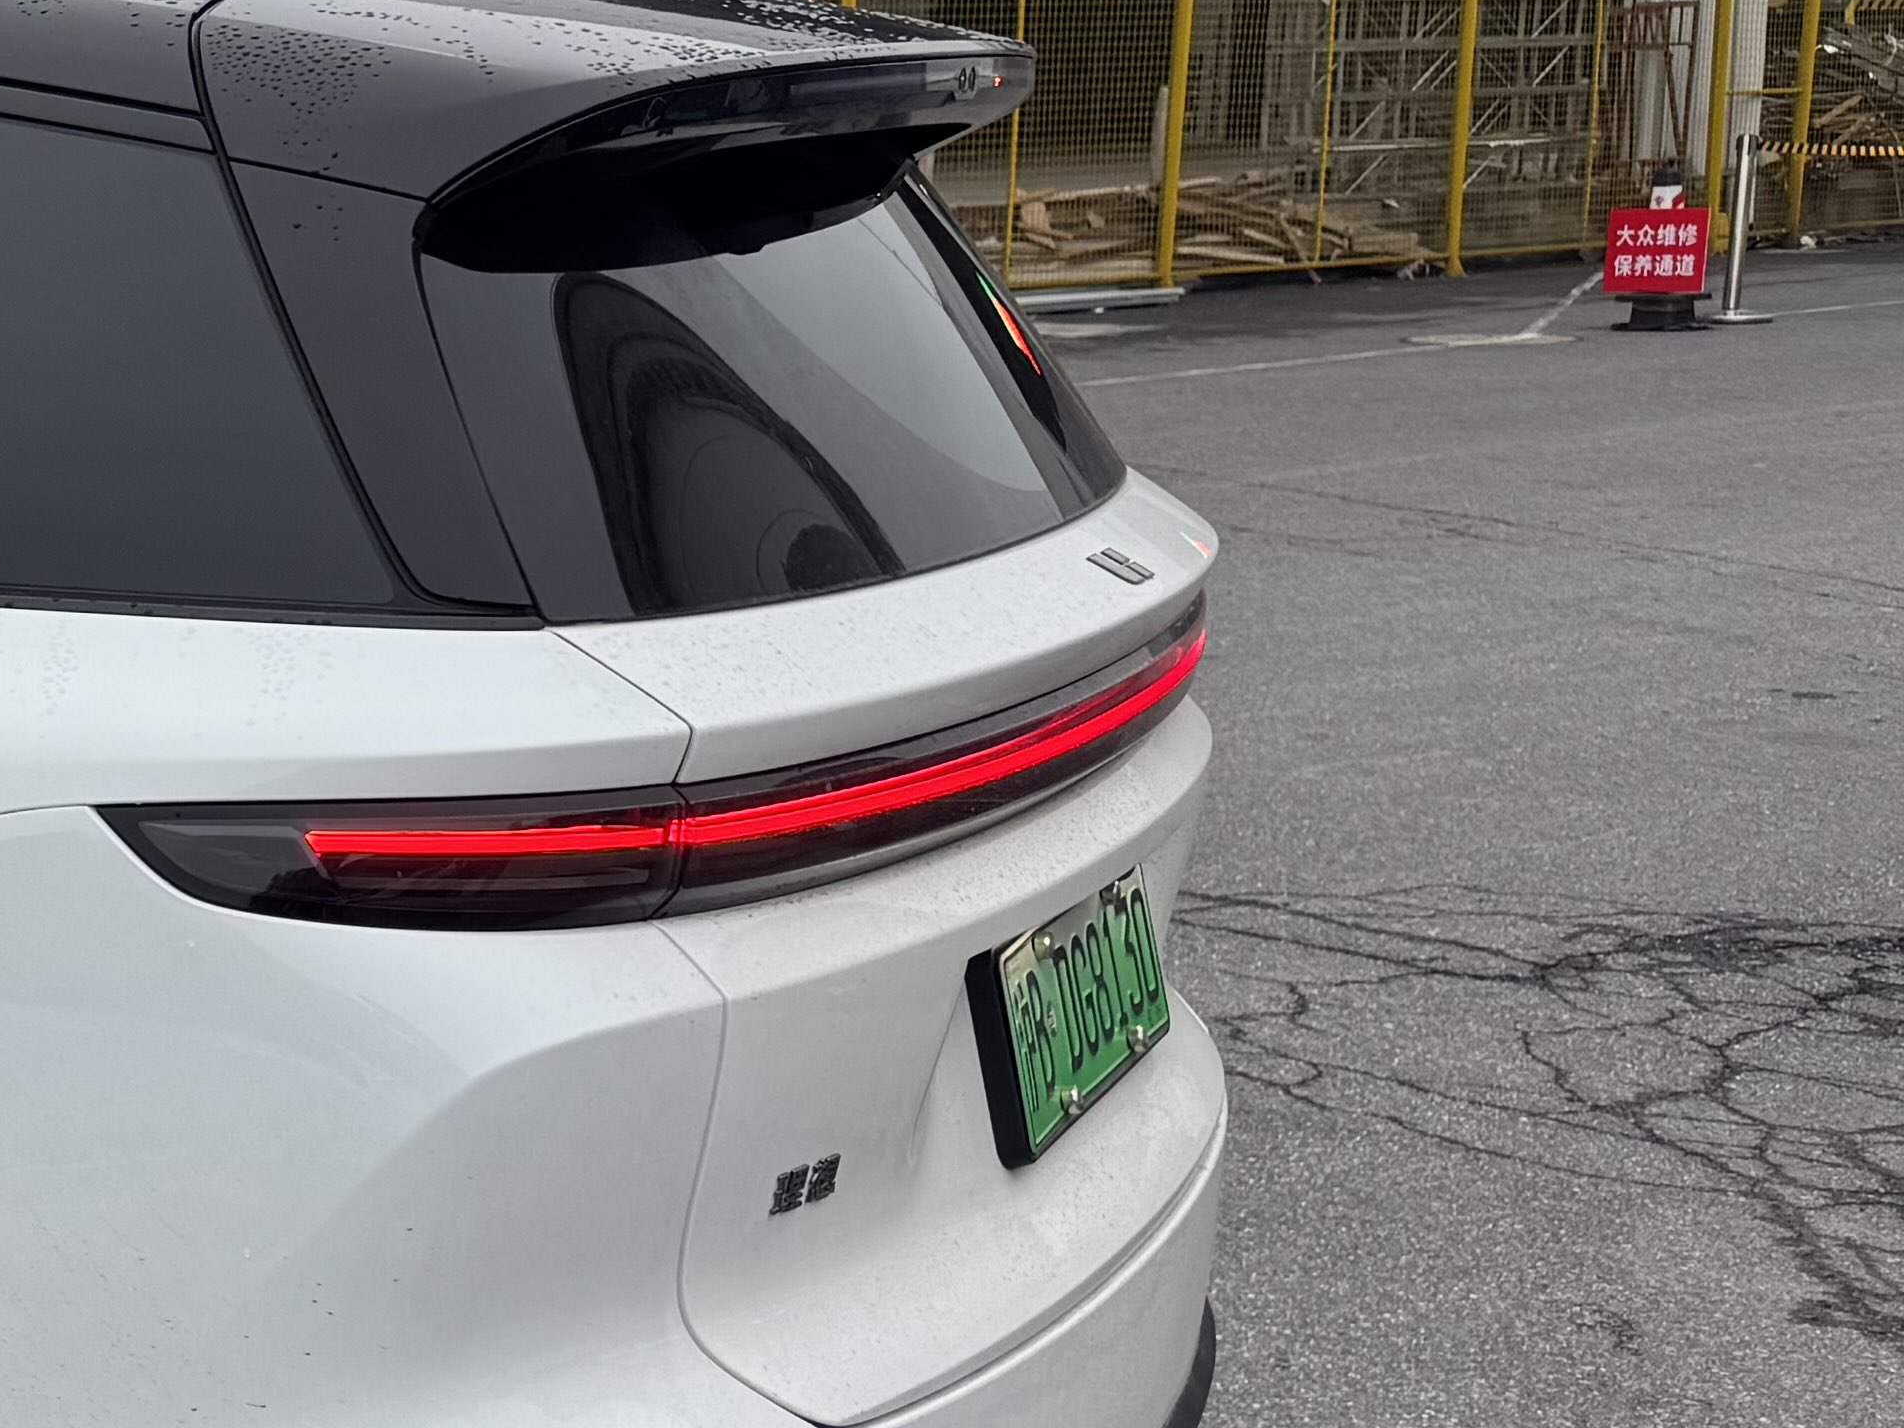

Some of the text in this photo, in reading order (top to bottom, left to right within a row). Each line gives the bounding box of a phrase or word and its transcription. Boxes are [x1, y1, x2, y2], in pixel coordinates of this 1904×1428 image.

[1616, 223, 1698, 247] 大众维修
[1614, 254, 1695, 277] 保养通道
